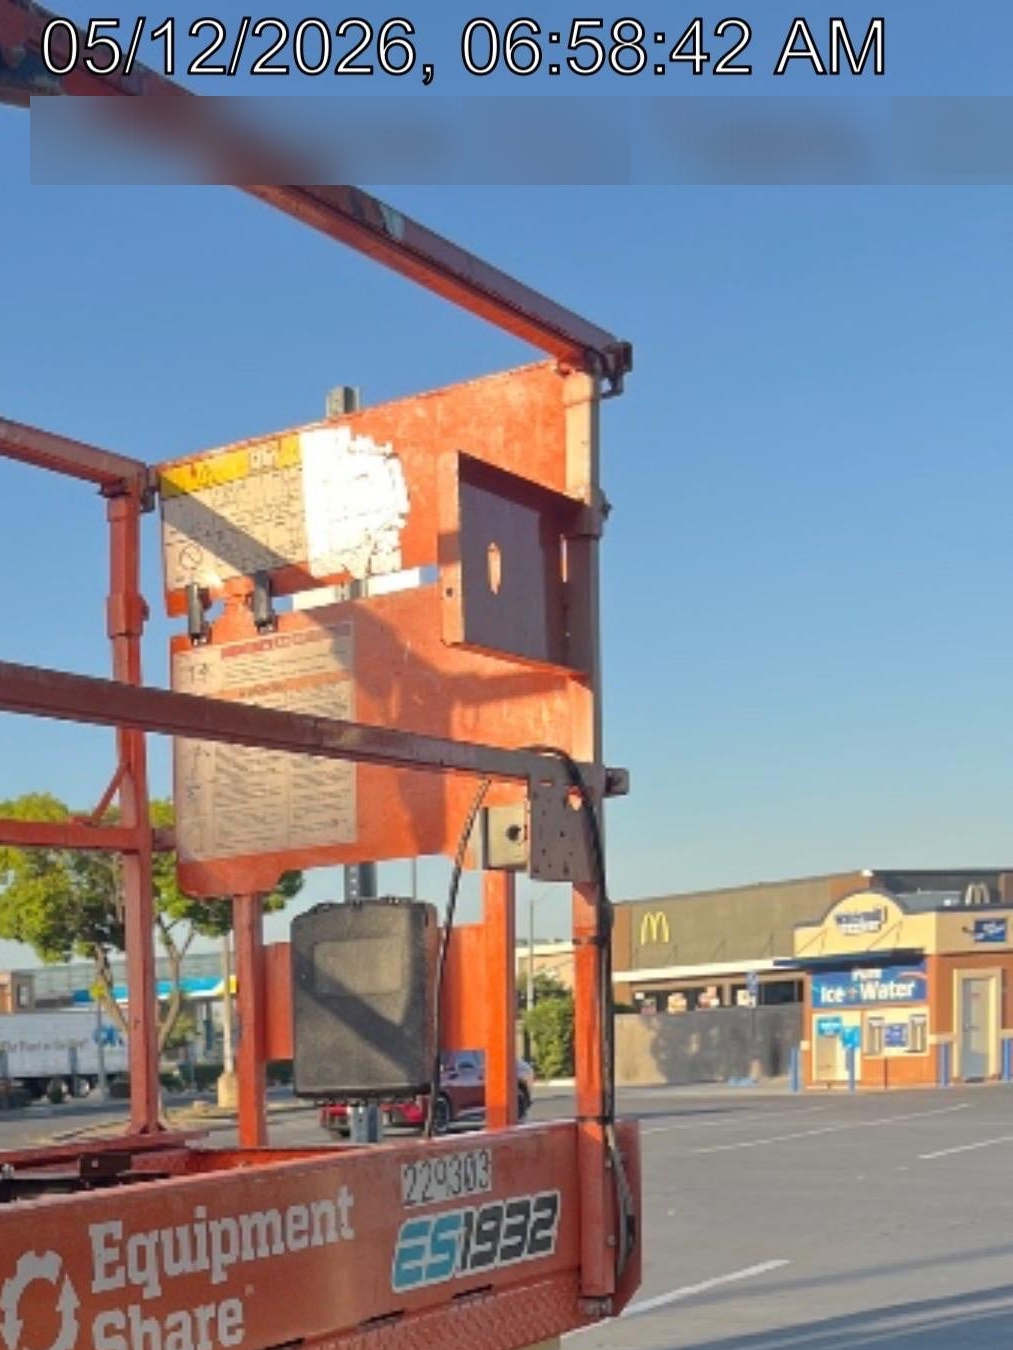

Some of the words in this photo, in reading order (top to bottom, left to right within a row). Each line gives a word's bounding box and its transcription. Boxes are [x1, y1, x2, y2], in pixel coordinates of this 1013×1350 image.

[859, 979, 917, 1003] Water
[88, 1184, 356, 1300] Equipment
[392, 1188, 561, 1292] ES1932
